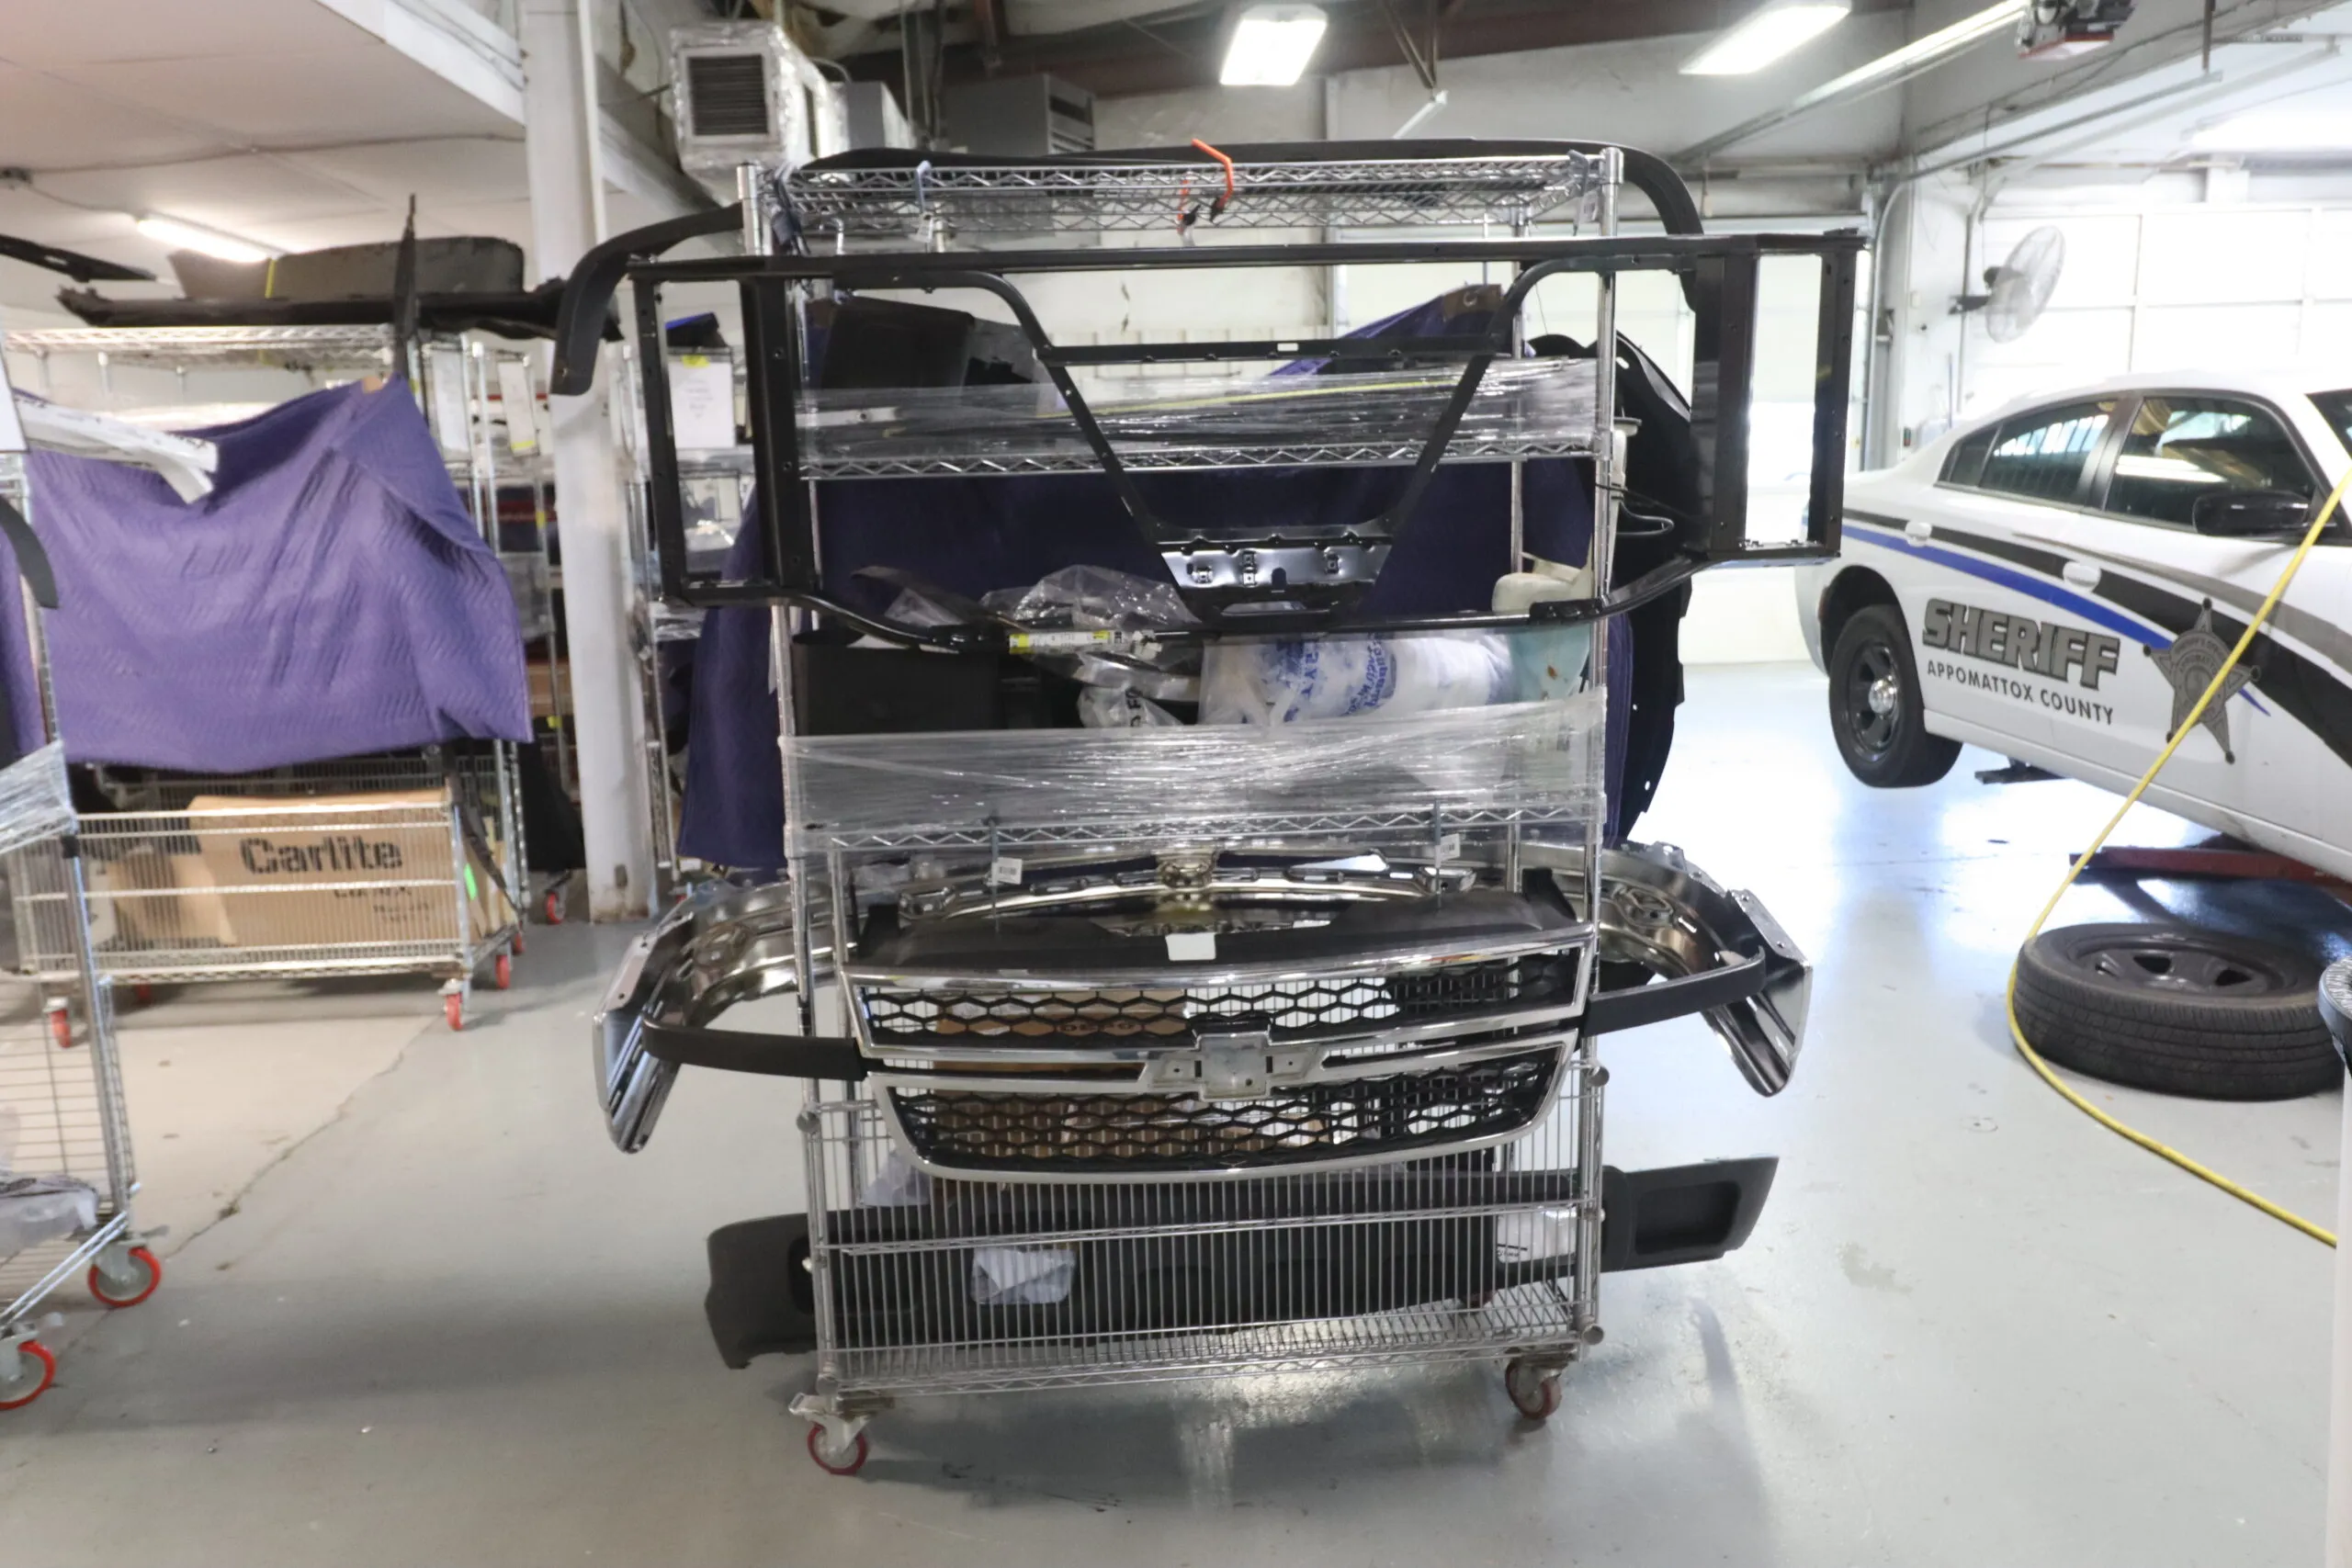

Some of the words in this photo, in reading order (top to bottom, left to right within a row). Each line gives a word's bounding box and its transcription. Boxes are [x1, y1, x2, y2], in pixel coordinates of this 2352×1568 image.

[1923, 598, 2120, 691] SHERIFF
[1928, 660, 2033, 703] APPOMATTOX
[2041, 689, 2113, 726] COUNTY
[240, 835, 402, 874] Carlite
